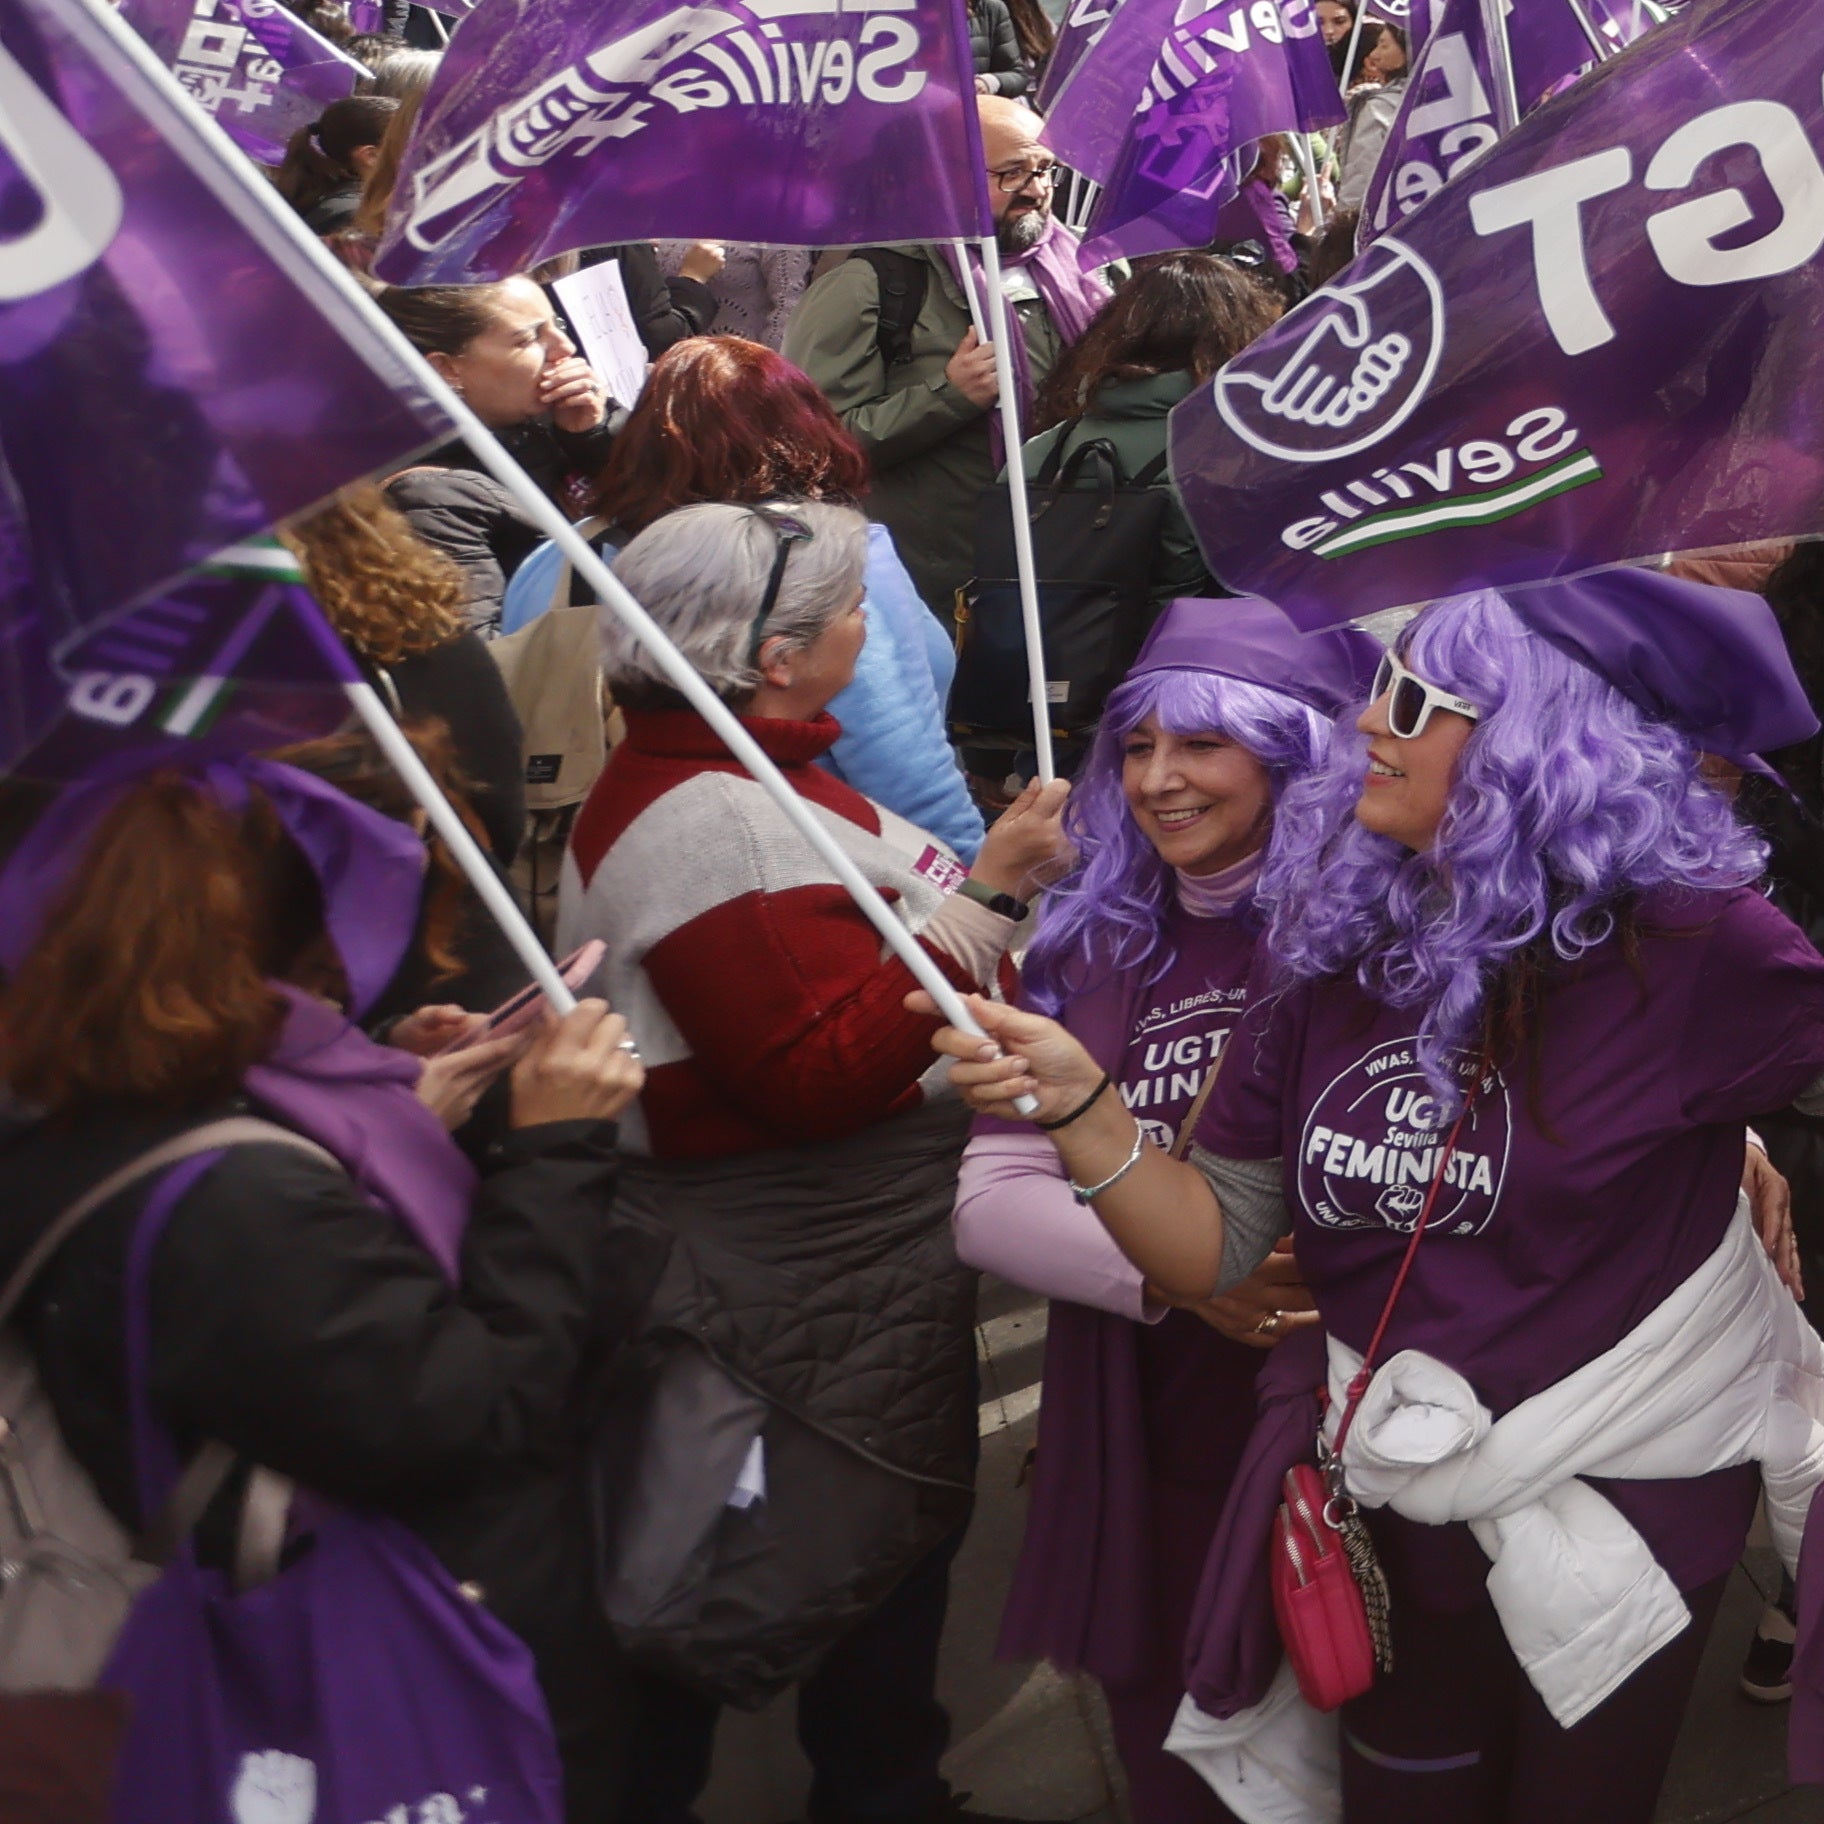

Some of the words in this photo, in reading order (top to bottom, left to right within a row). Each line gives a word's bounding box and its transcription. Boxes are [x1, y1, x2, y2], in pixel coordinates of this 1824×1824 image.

[1144, 1028, 1230, 1071] UGT
[1365, 1050, 1414, 1077] VIVAS,
[1383, 1126, 1438, 1148] Sevilla
[1315, 1201, 1340, 1226] UNA
